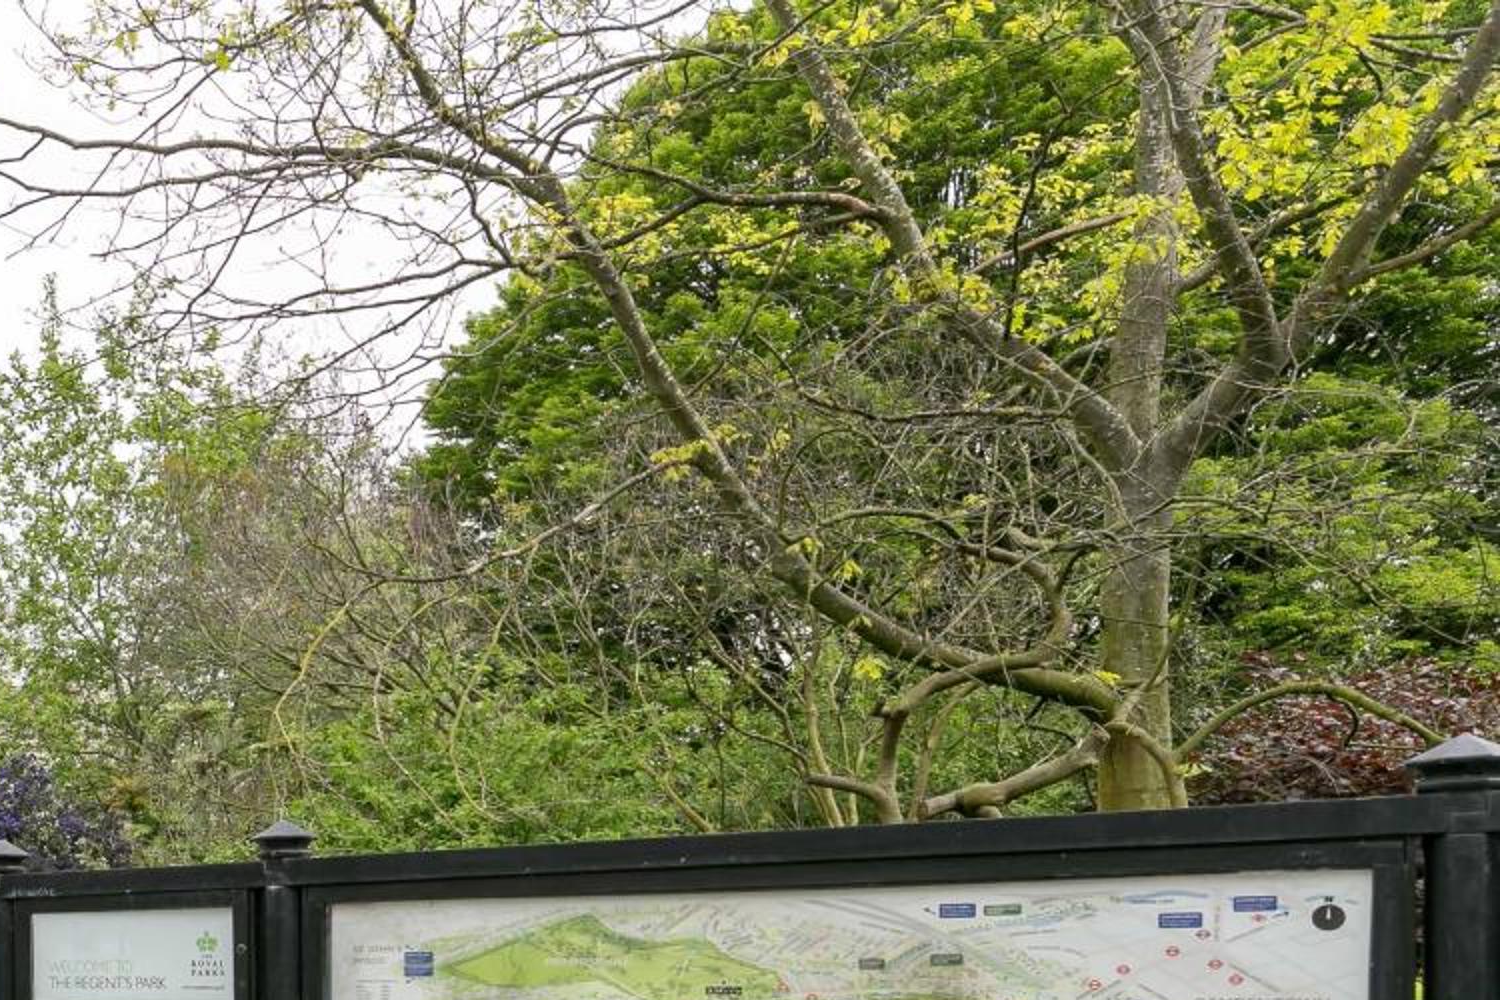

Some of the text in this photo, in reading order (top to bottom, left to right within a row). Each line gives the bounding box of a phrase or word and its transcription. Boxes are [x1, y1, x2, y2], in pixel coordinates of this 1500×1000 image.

[190, 960, 226, 968] ROYAL
[190, 969, 226, 977] PARKS
[50, 975, 71, 990] THE
[135, 976, 168, 990] PARK
